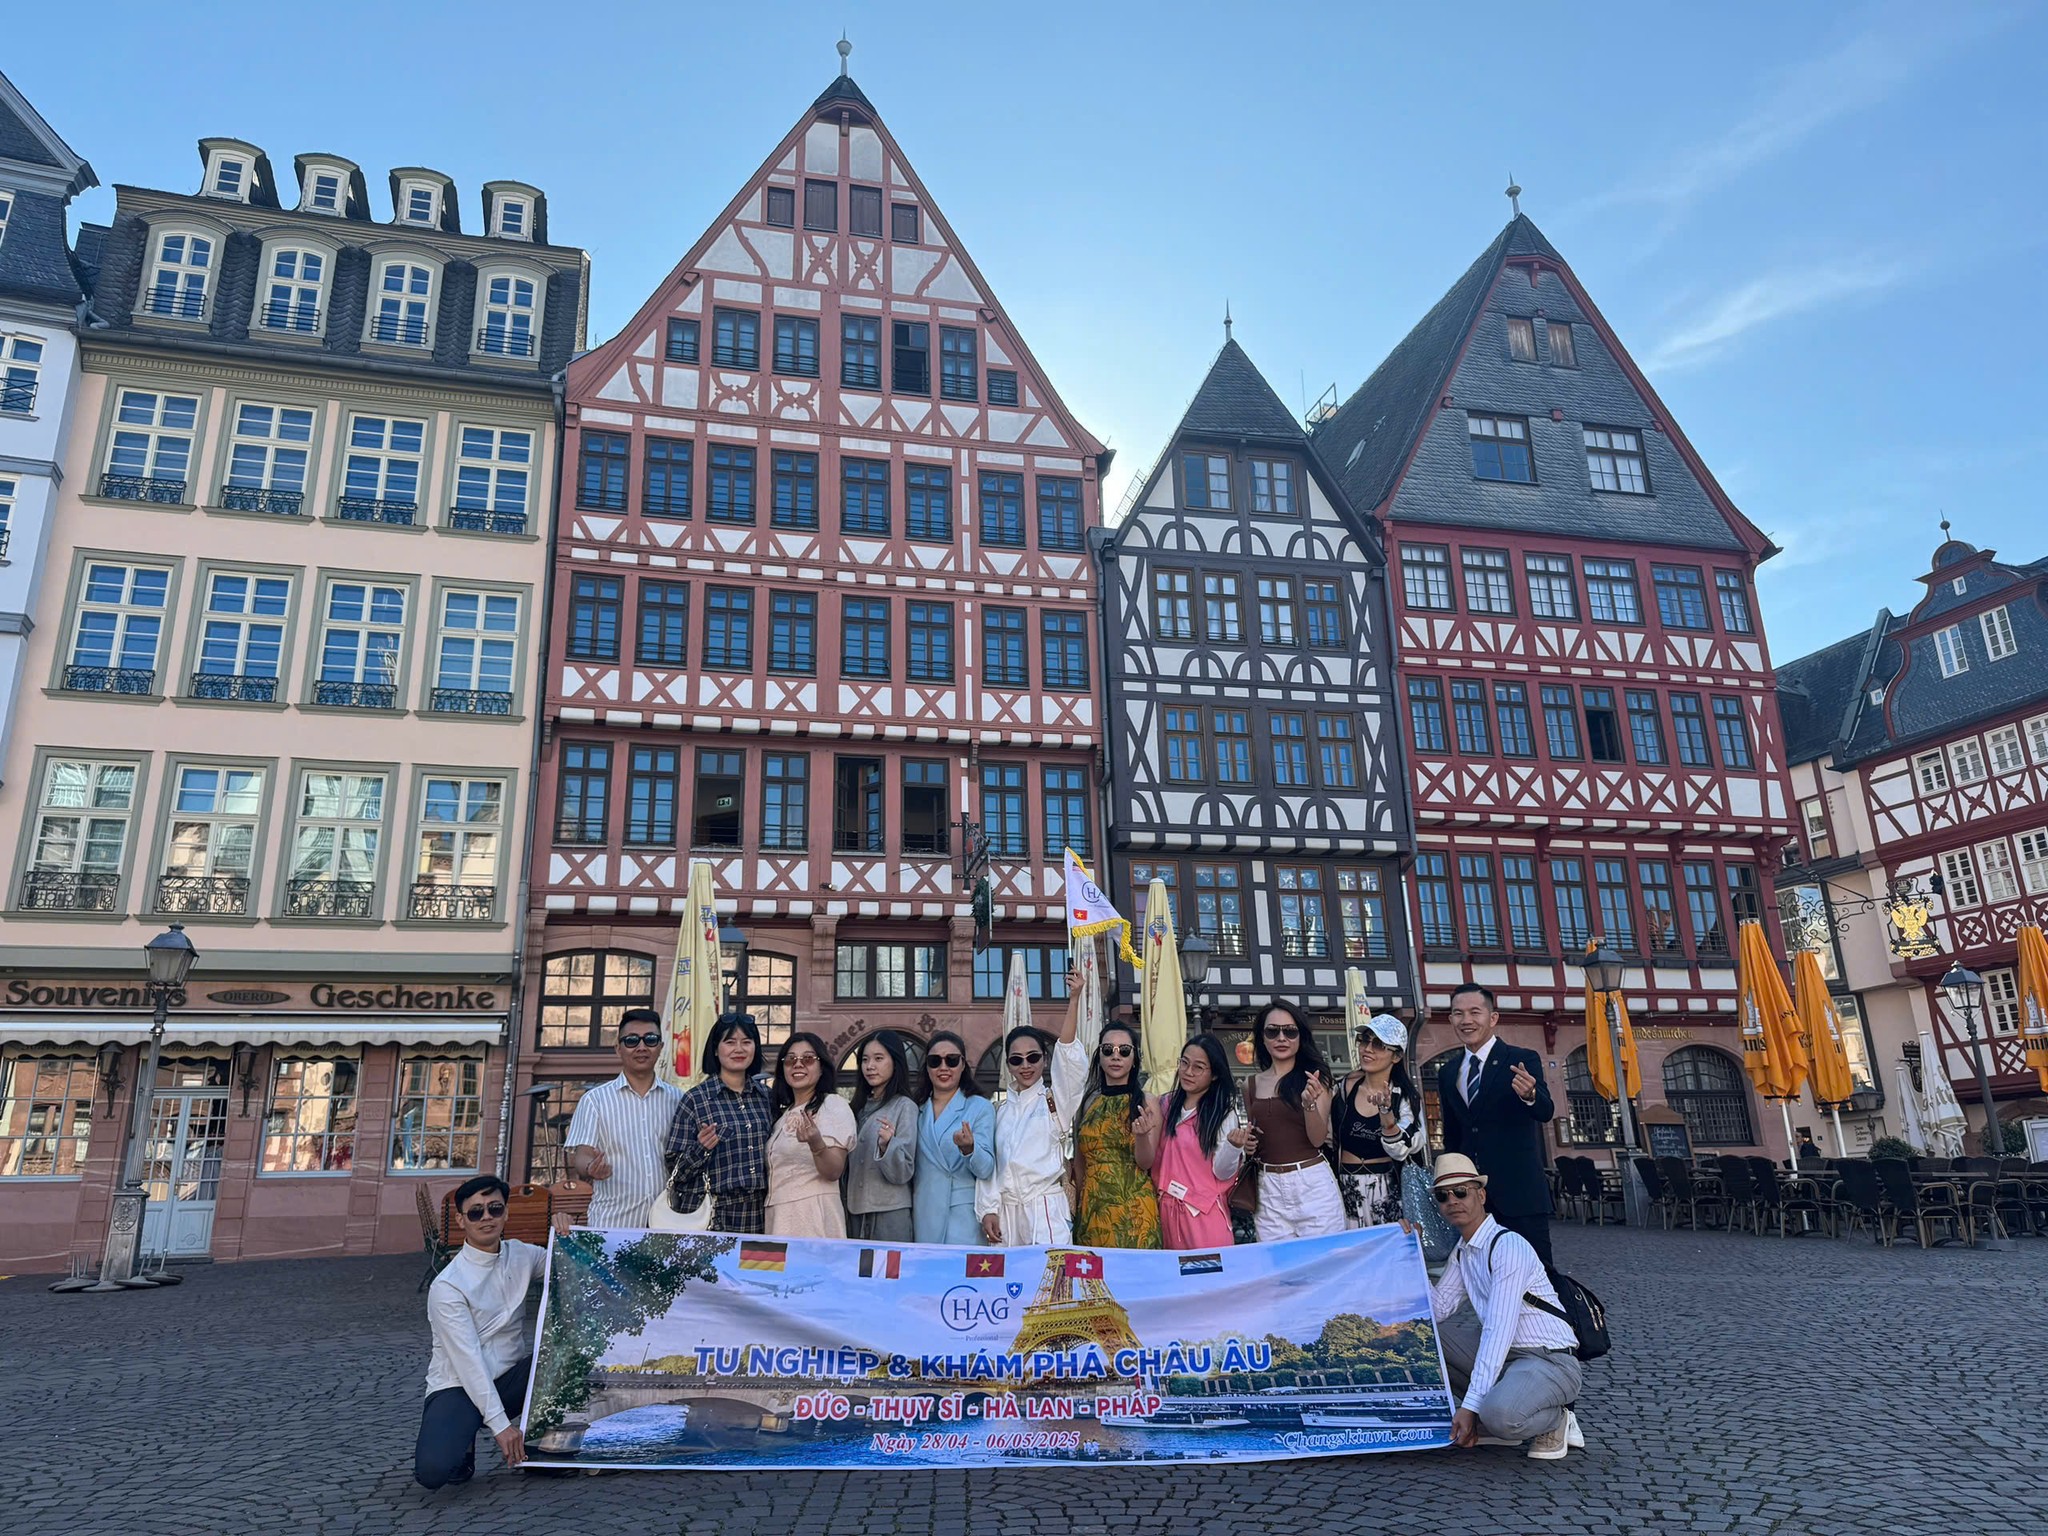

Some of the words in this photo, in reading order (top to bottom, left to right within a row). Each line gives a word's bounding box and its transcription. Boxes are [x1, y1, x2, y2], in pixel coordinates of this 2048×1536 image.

[6, 980, 187, 1007] Souvenis
[310, 983, 495, 1010] Geschenke
[826, 1018, 866, 1057] ömer
[693, 1346, 740, 1374] TU
[749, 1344, 880, 1383] NGHIỆP
[888, 1354, 912, 1377] &
[921, 1347, 1023, 1378] KHÁM
[1033, 1344, 1106, 1377] PHÁ
[1114, 1340, 1213, 1376] CHÂU
[1221, 1338, 1272, 1372] ÂU
[795, 1391, 849, 1419] ĐỨC
[871, 1397, 932, 1425] THỤY
[939, 1394, 964, 1419] SĨ
[984, 1393, 1021, 1418] HÀ
[1028, 1397, 1073, 1418] LAN
[1096, 1389, 1161, 1416] PHÁP
[871, 1434, 916, 1453] Ngày
[921, 1433, 969, 1450] 28/04
[985, 1431, 1081, 1449] 06/05/2025
